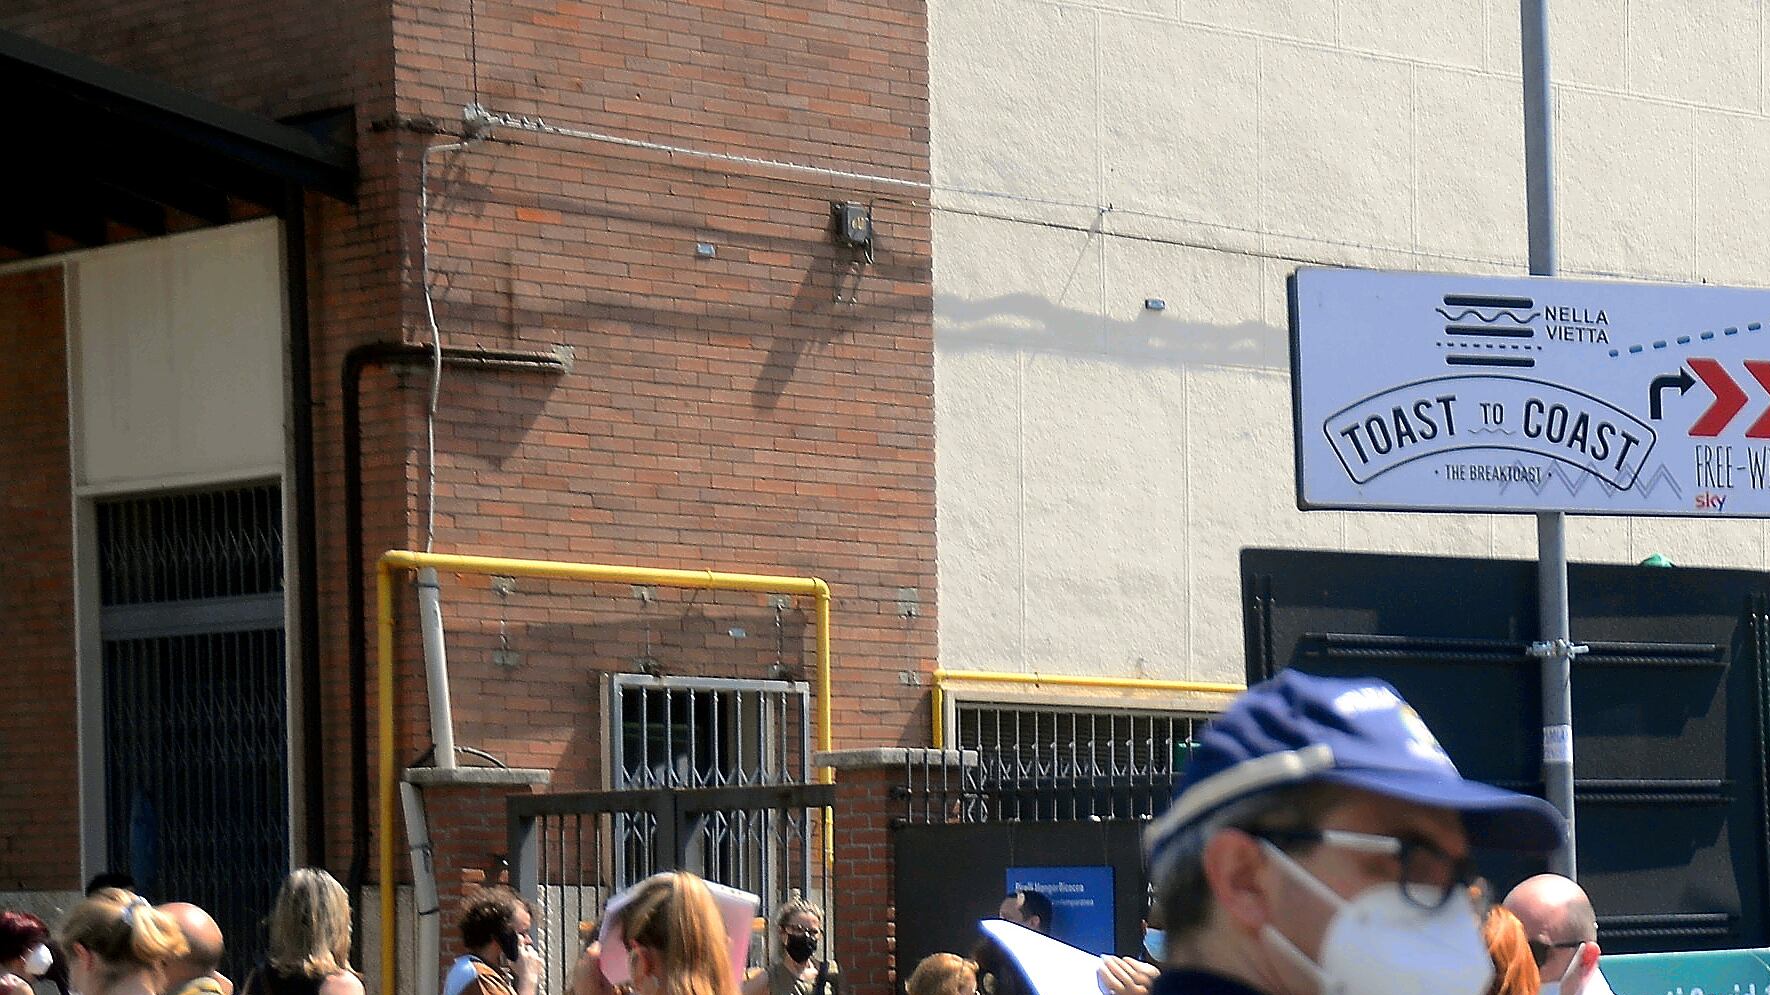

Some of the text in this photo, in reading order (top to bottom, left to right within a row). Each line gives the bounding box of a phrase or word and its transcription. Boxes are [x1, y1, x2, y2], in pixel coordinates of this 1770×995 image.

[1545, 305, 1608, 325] NELLA
[1546, 325, 1609, 344] VIETTA
[1340, 394, 1640, 471] TOAST TO COAST
[1445, 463, 1468, 480] THE
[1695, 491, 1727, 511] sky
